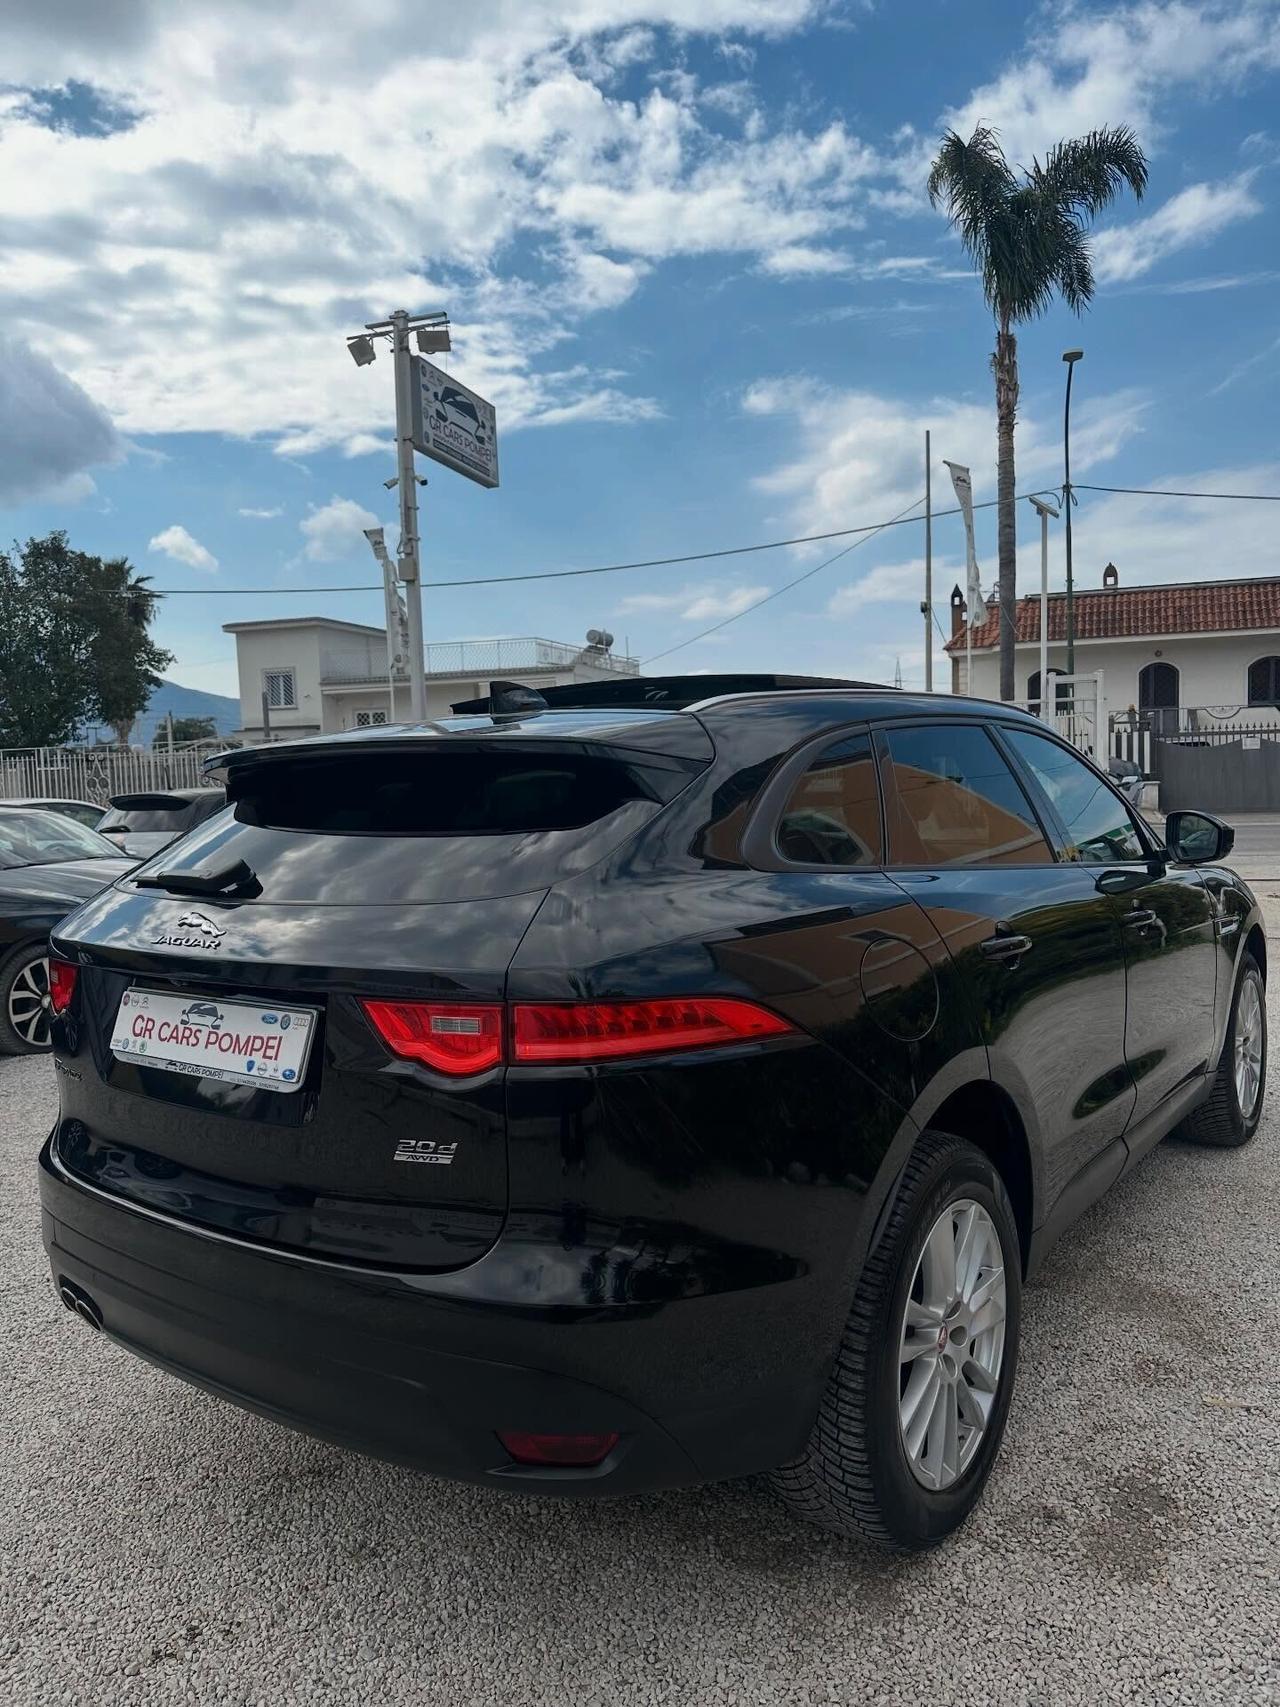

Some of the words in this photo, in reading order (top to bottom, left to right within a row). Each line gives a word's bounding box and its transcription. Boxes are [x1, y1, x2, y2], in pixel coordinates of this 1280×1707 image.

[443, 424, 463, 446] CARS
[464, 437, 492, 463] POMPEI
[151, 936, 221, 950] JAGUAR
[132, 1014, 155, 1039] GR
[158, 1022, 200, 1047] CARS
[205, 1030, 283, 1061] POMPEI
[178, 1063, 187, 1072] GR
[187, 1065, 201, 1074] CARS
[202, 1069, 224, 1079] POMPEI
[397, 1139, 458, 1154] 20d
[406, 1154, 439, 1162] AWD
